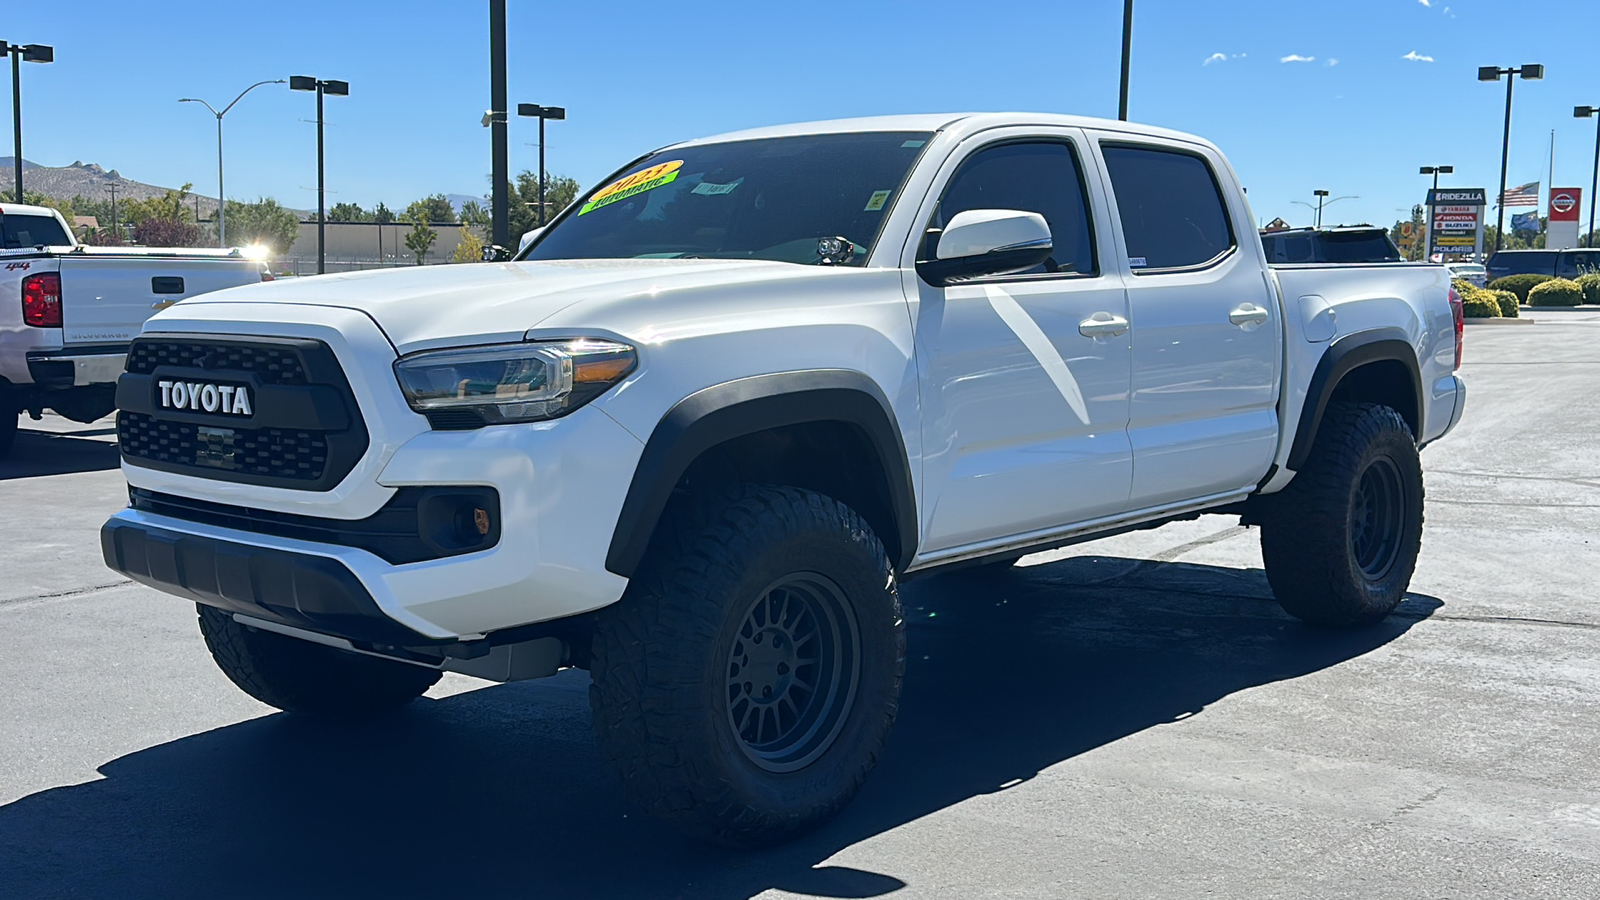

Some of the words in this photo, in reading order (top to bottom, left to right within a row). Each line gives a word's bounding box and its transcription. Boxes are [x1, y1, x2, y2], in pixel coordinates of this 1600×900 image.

[591, 176, 666, 209] AUTOMATIC
[601, 164, 668, 197] 2023
[159, 381, 252, 415] TOYOTA
